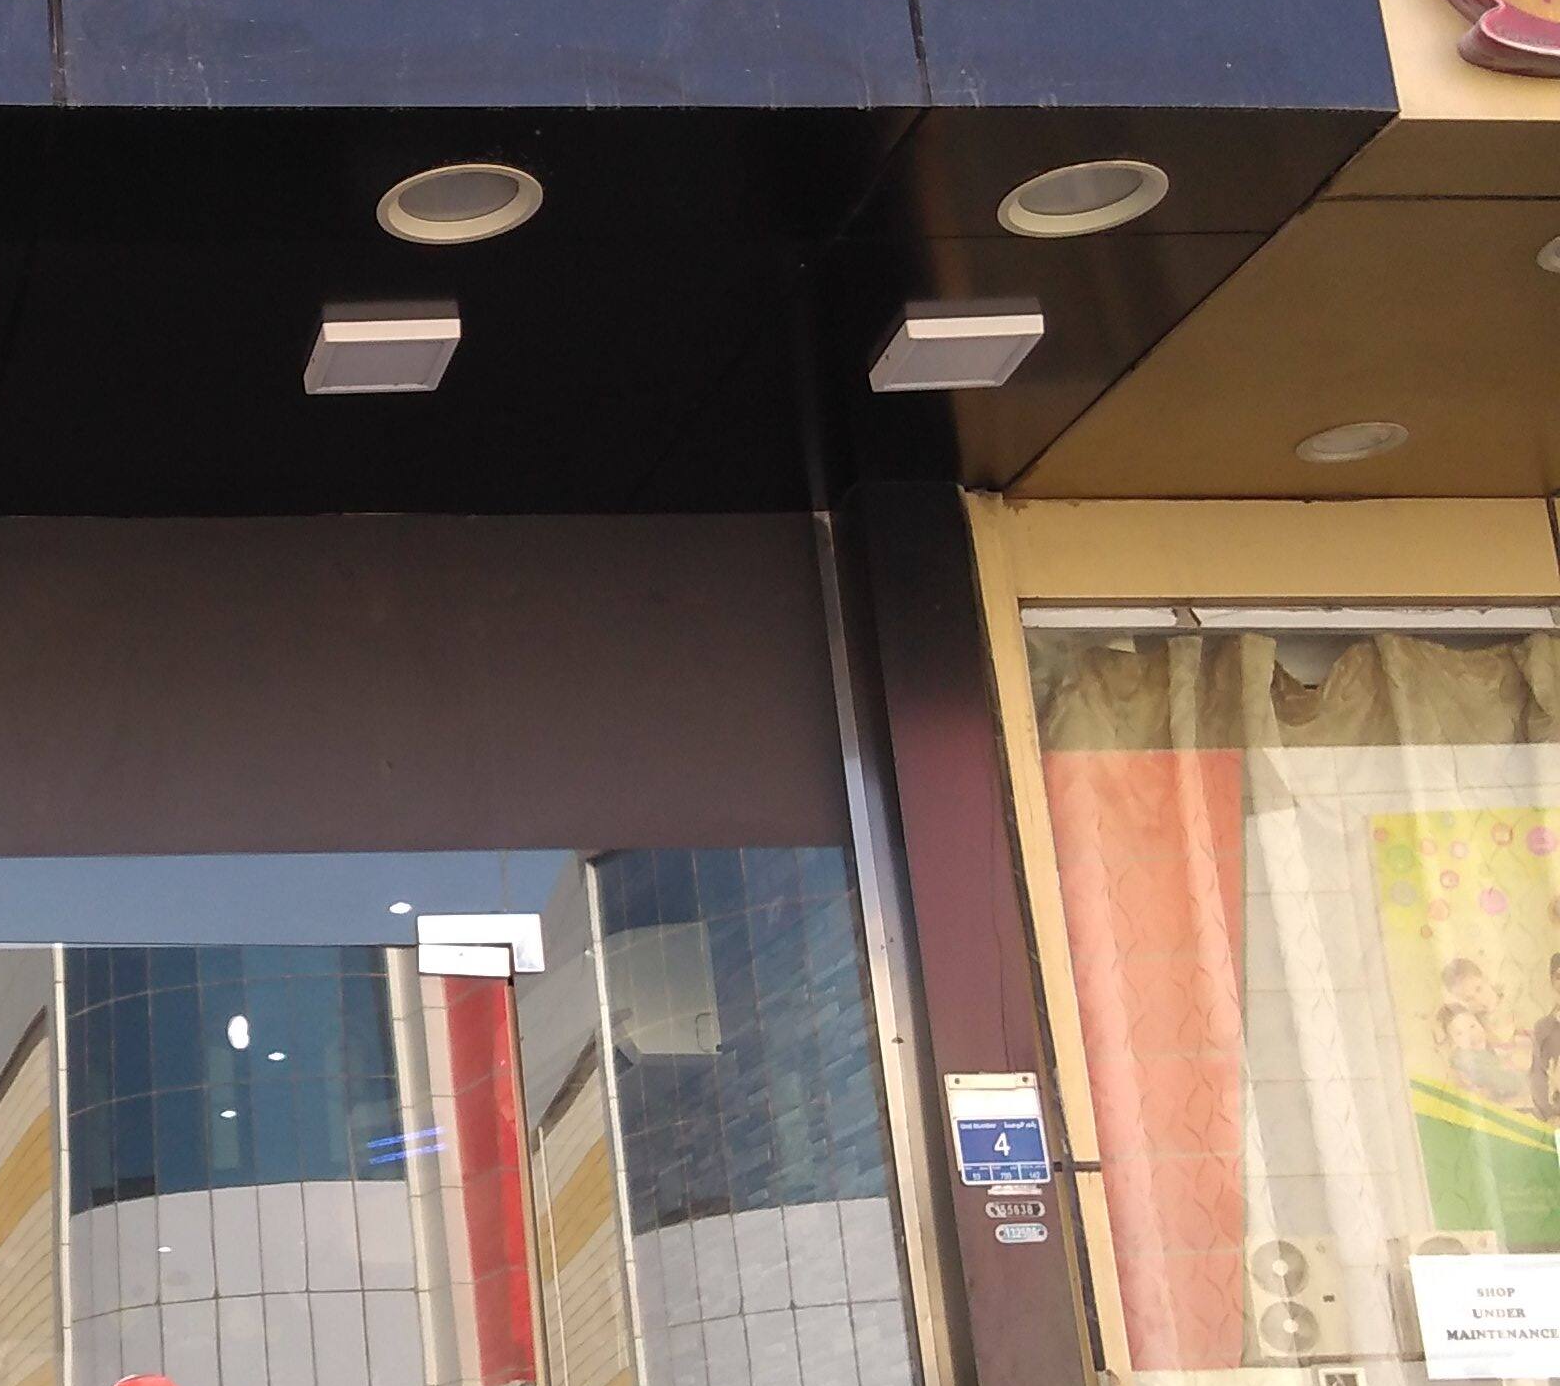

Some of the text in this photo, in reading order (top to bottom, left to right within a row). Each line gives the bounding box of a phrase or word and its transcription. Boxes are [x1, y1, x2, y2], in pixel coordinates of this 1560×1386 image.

[994, 1132, 1011, 1156] 4
[1476, 1287, 1516, 1298] SHOP
[1471, 1308, 1527, 1319] UNDER
[1446, 1328, 1560, 1341] MAINTENANCE
